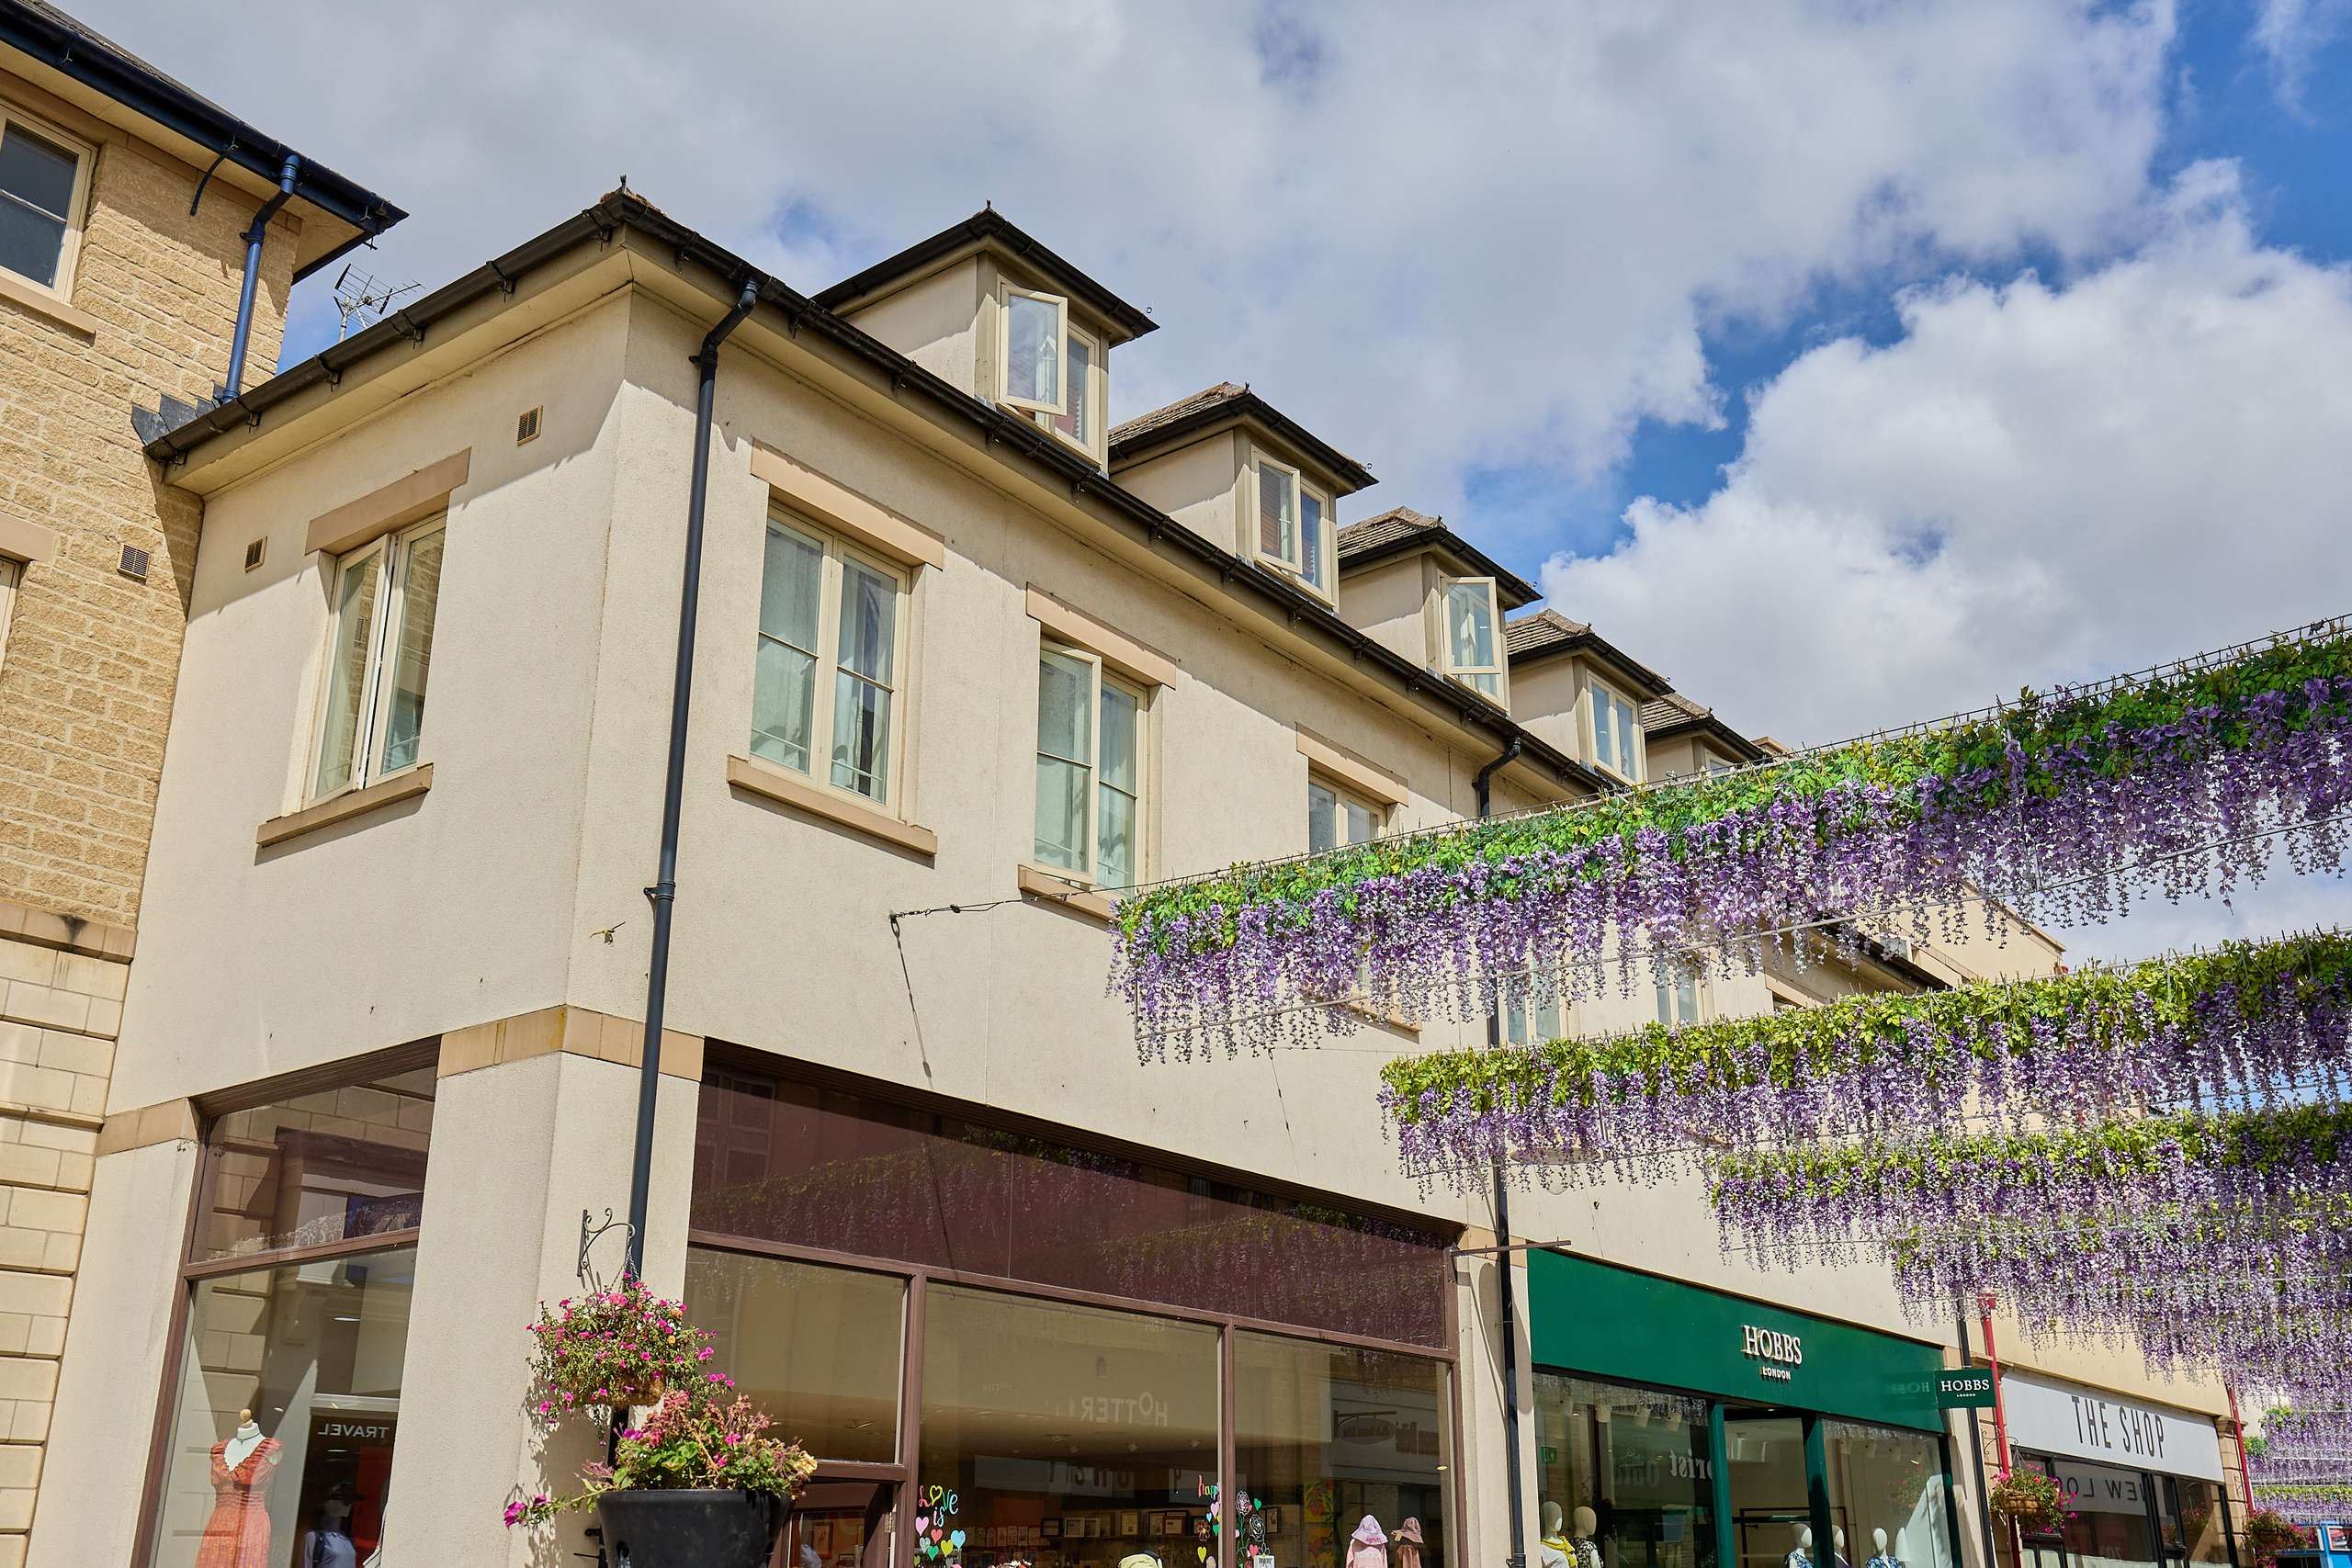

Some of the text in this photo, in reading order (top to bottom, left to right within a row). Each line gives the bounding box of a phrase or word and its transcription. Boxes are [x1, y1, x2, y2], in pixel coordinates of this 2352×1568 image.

[1742, 1325, 1803, 1365] HOBBS
[1761, 1366, 1792, 1380] LONDON
[1940, 1379, 1981, 1393] HOBBS
[2071, 1395, 2165, 1459] THE SHOP
[933, 1506, 945, 1528] is
